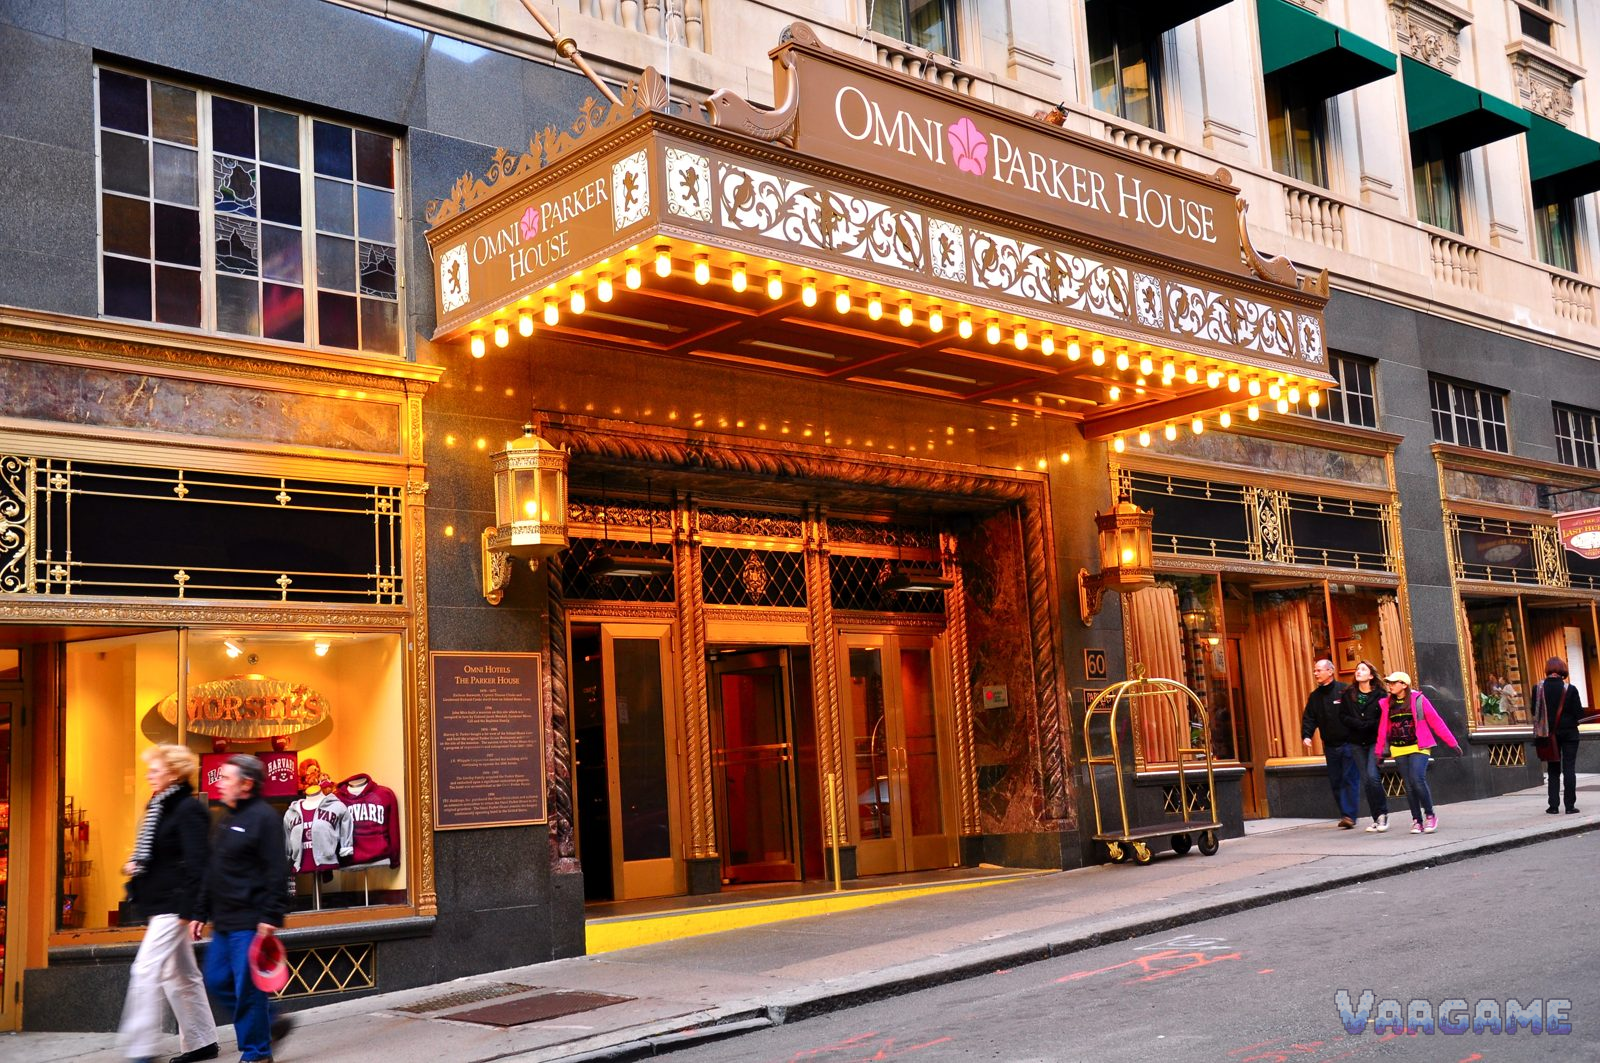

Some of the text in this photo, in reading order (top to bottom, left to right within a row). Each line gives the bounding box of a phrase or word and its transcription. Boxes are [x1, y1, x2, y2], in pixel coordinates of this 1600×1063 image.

[835, 85, 1218, 244] OMNI PARKER HOUSE
[472, 177, 609, 265] OMNI PARKER
[508, 230, 571, 282] HOUSE
[1562, 527, 1583, 539] LAST
[463, 664, 511, 674] OMNI HOTELS
[1088, 654, 1105, 675] 60
[454, 676, 520, 685] THE PARKER HOUSE
